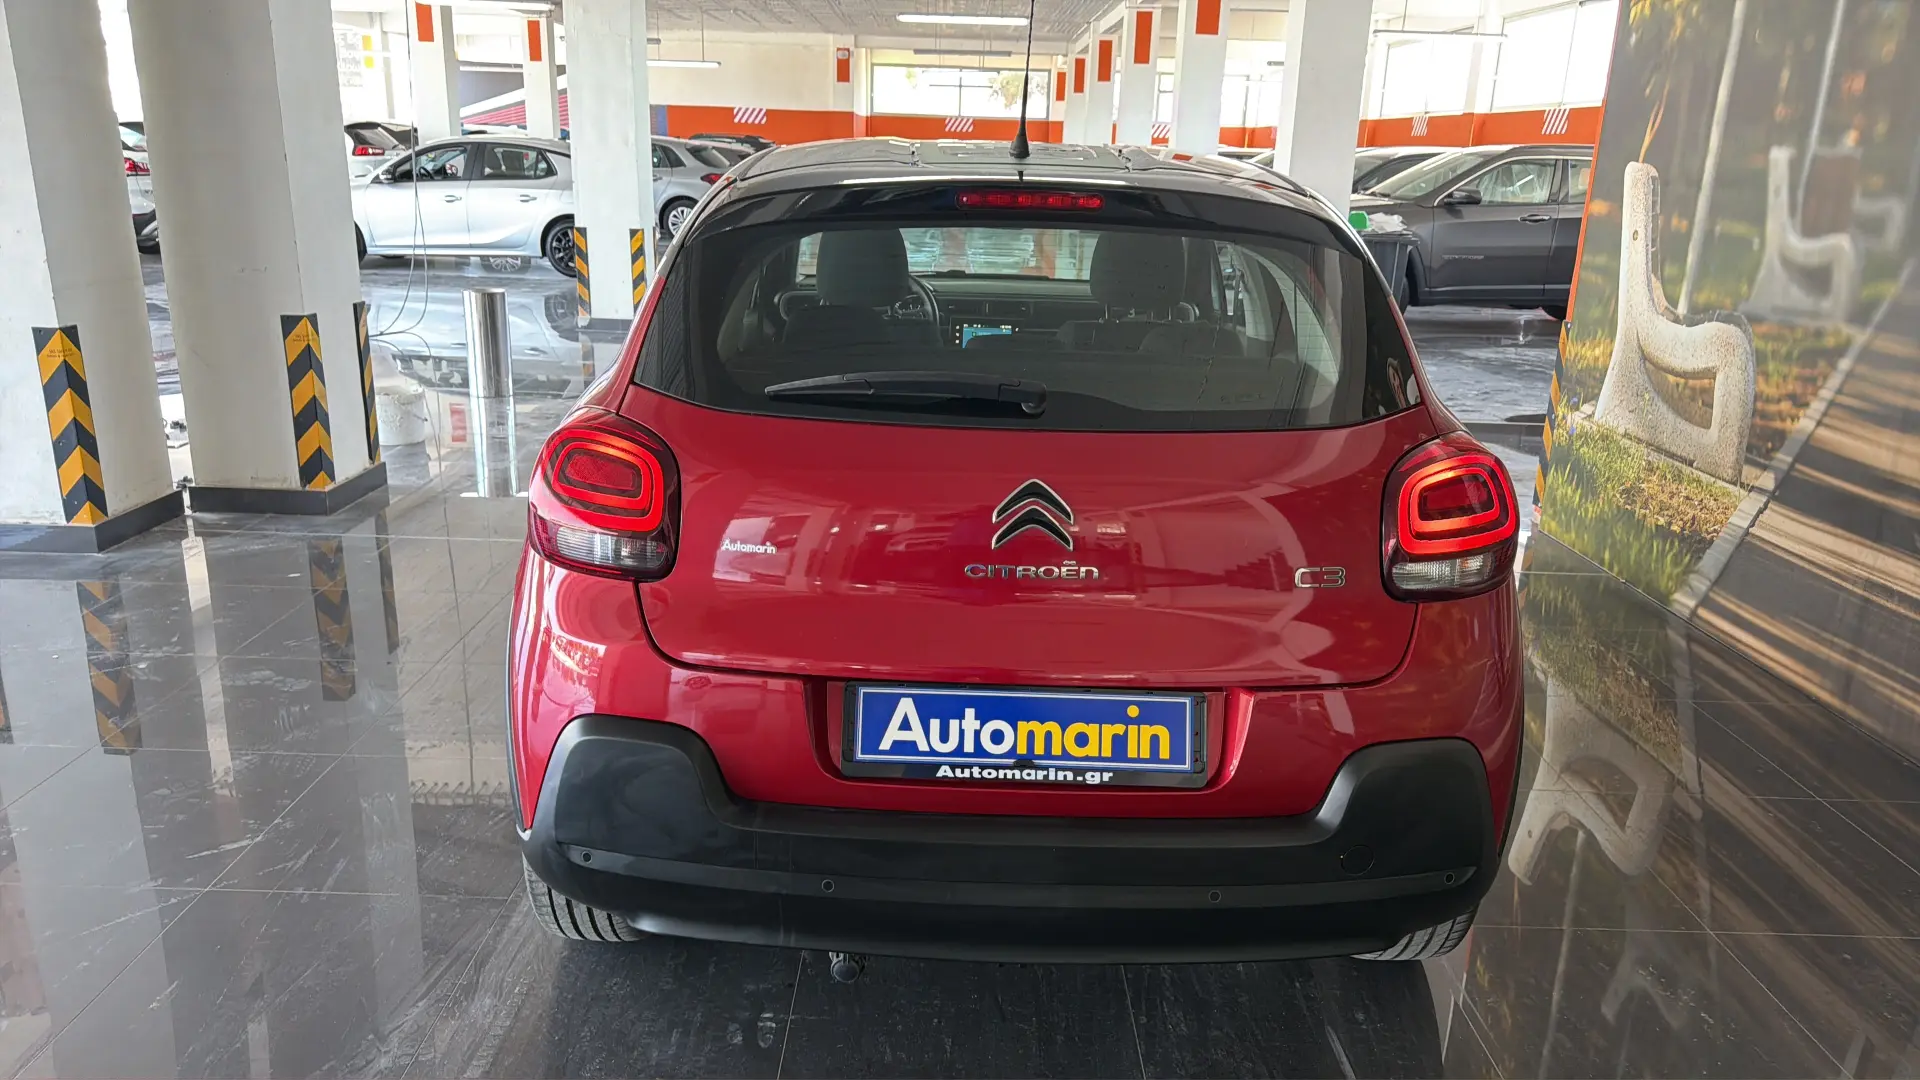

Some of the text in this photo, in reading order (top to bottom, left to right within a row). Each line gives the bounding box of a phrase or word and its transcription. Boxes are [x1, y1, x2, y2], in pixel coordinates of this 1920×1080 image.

[720, 539, 777, 554] Automarin
[1295, 566, 1346, 588] C3
[878, 697, 1170, 759] Automarin
[936, 764, 1113, 784] Automarin.gr
